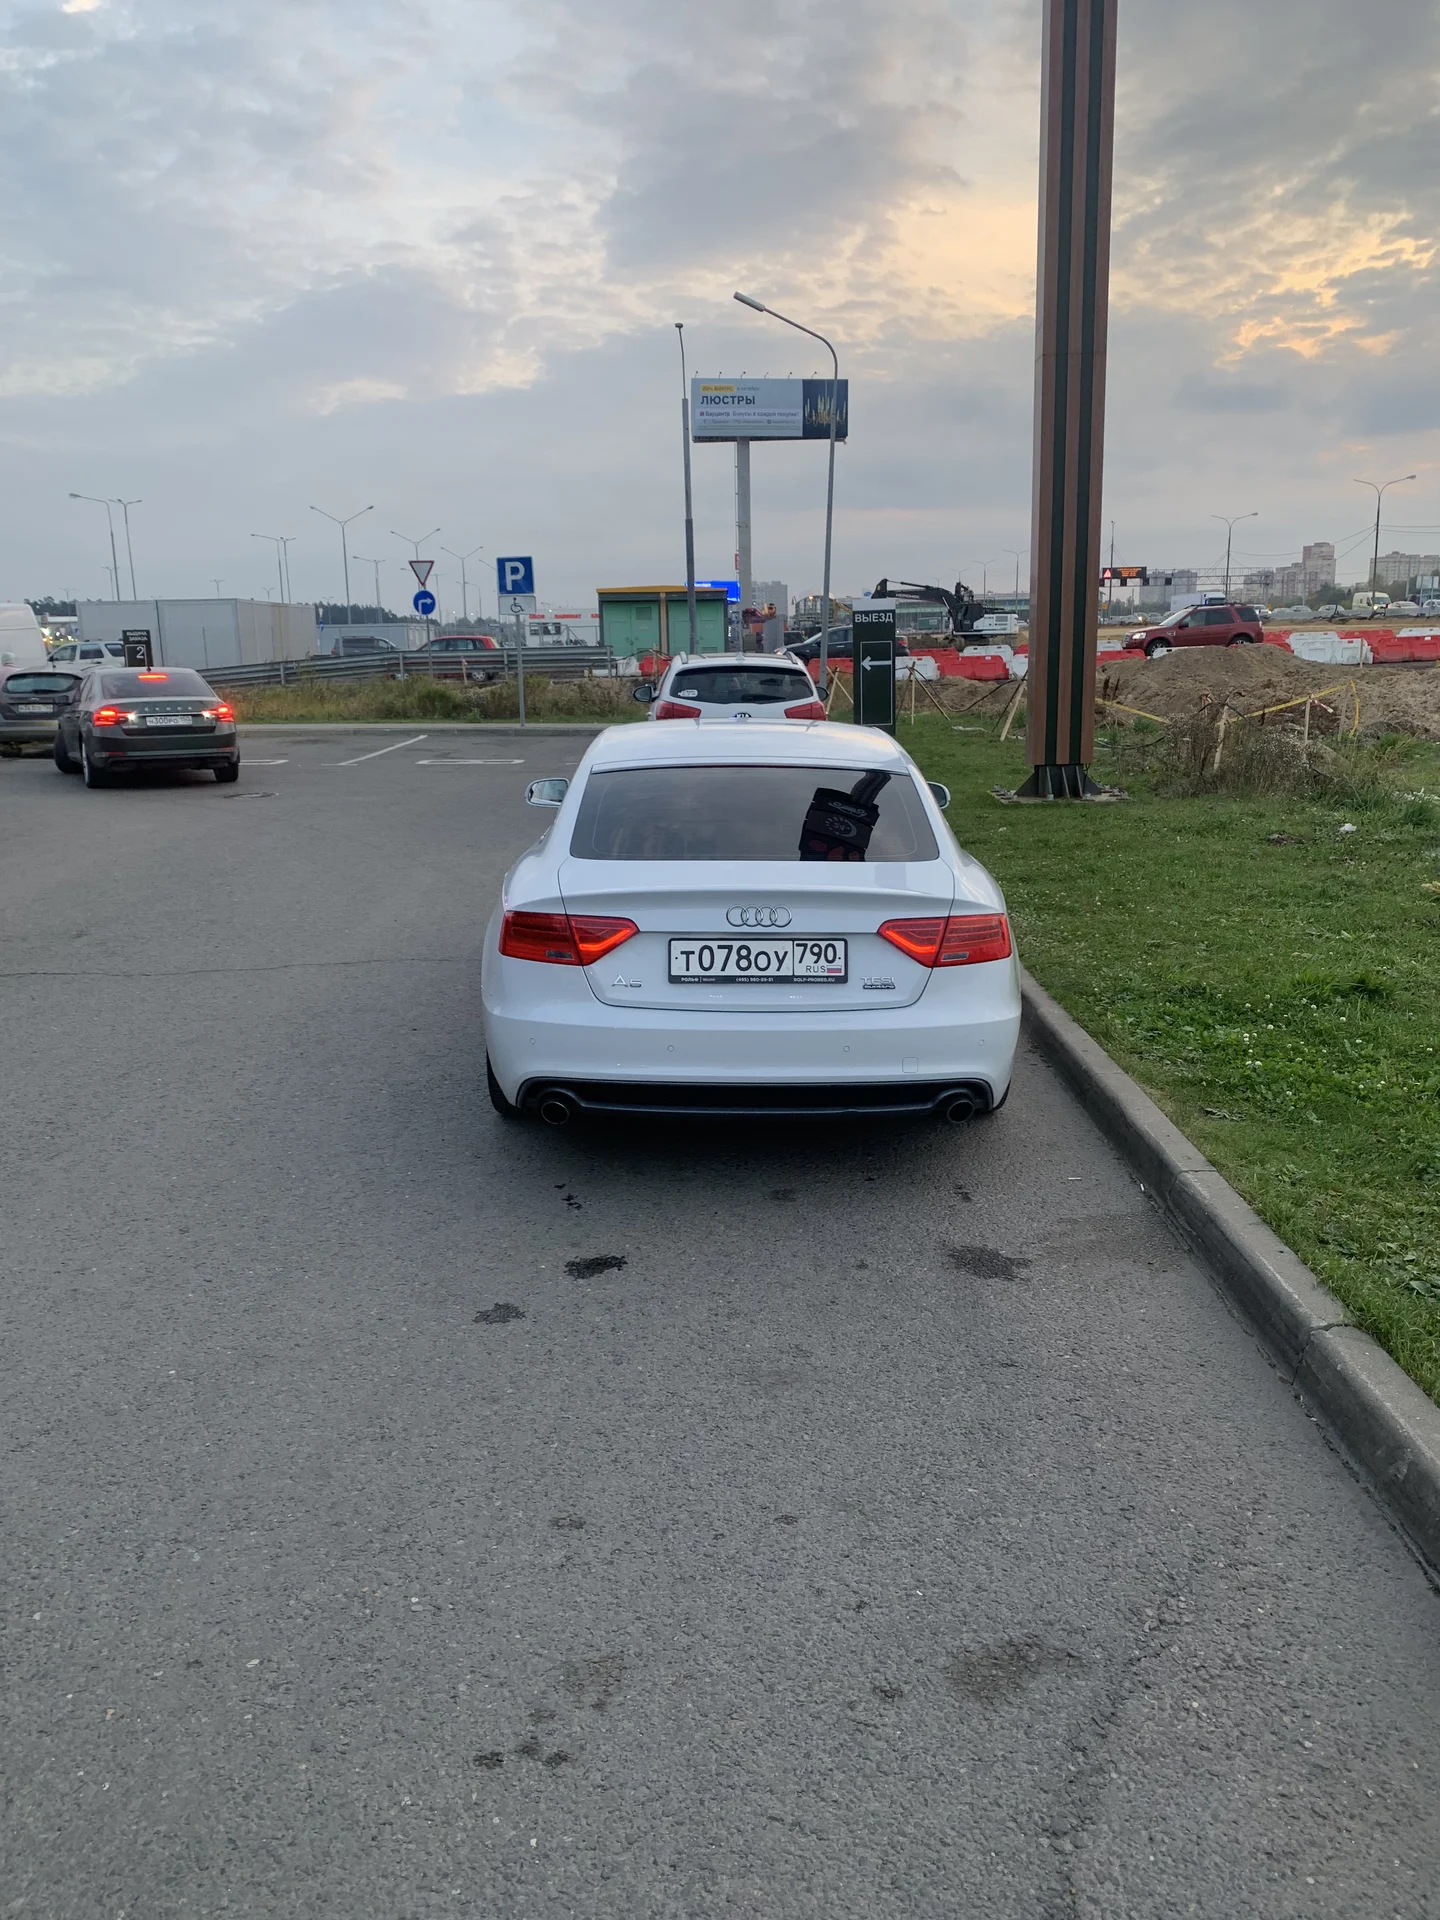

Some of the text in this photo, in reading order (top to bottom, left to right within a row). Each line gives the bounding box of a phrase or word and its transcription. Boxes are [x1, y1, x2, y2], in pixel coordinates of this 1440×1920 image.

[700, 395, 755, 405] ЛЮСТРЫ
[504, 561, 526, 591] P
[854, 612, 894, 623] ВЫЕЗД
[136, 646, 144, 658] 2
[795, 943, 837, 964] 790
[805, 965, 826, 973] RUS
[611, 974, 642, 987] A5
